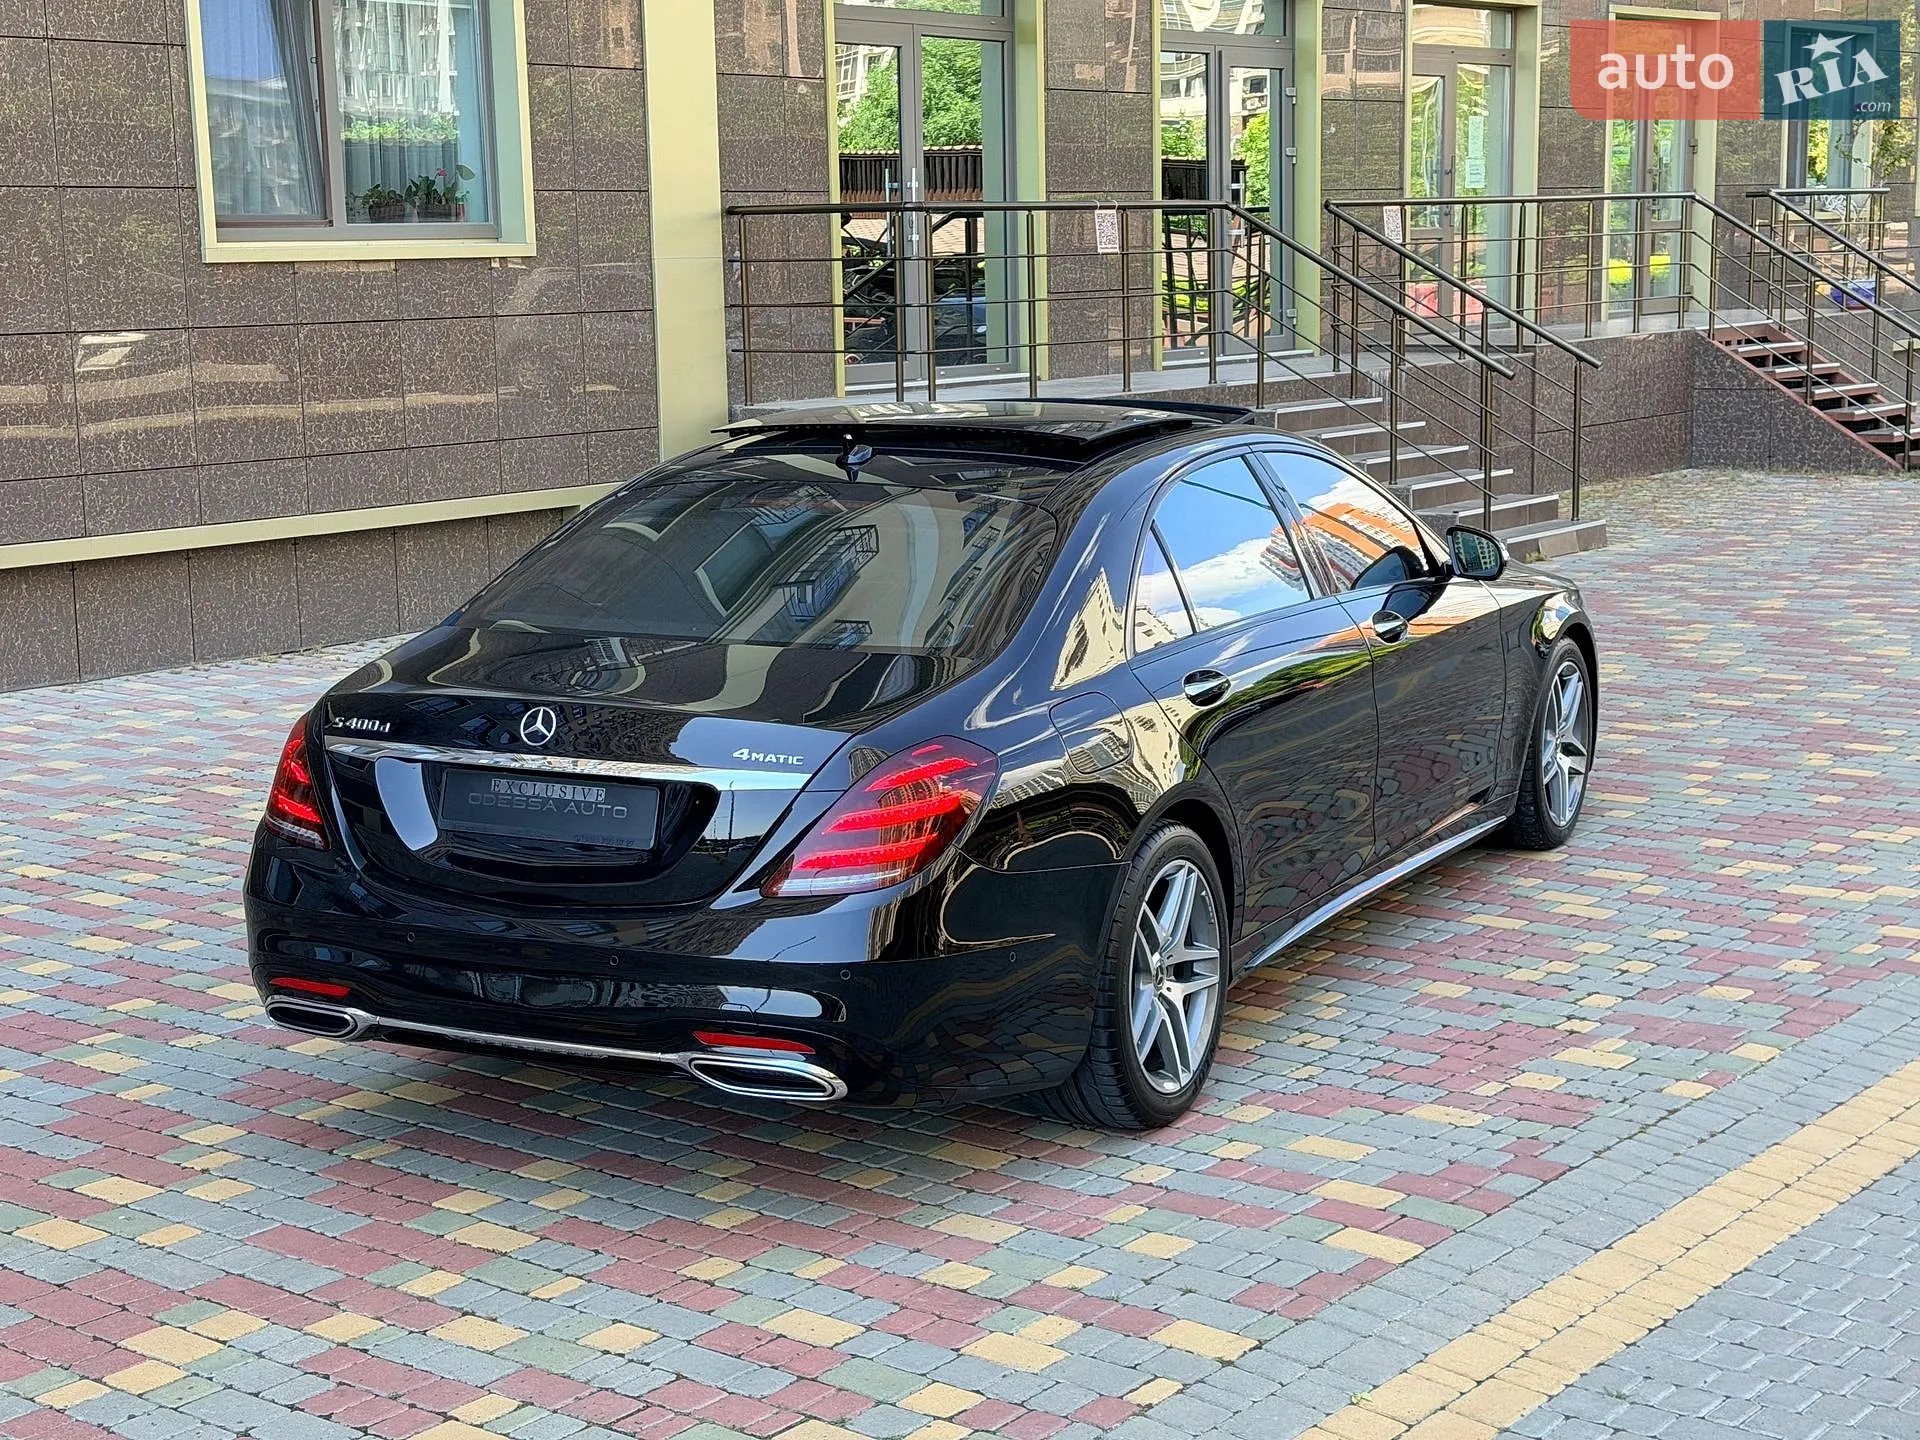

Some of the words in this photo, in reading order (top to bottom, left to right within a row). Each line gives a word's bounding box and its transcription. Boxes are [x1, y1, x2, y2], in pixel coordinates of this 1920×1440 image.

[732, 748, 805, 765] 4MATIC
[492, 779, 606, 802] EXCLUSIVE
[468, 792, 557, 812] ODESSA
[563, 802, 628, 819] AUTO
